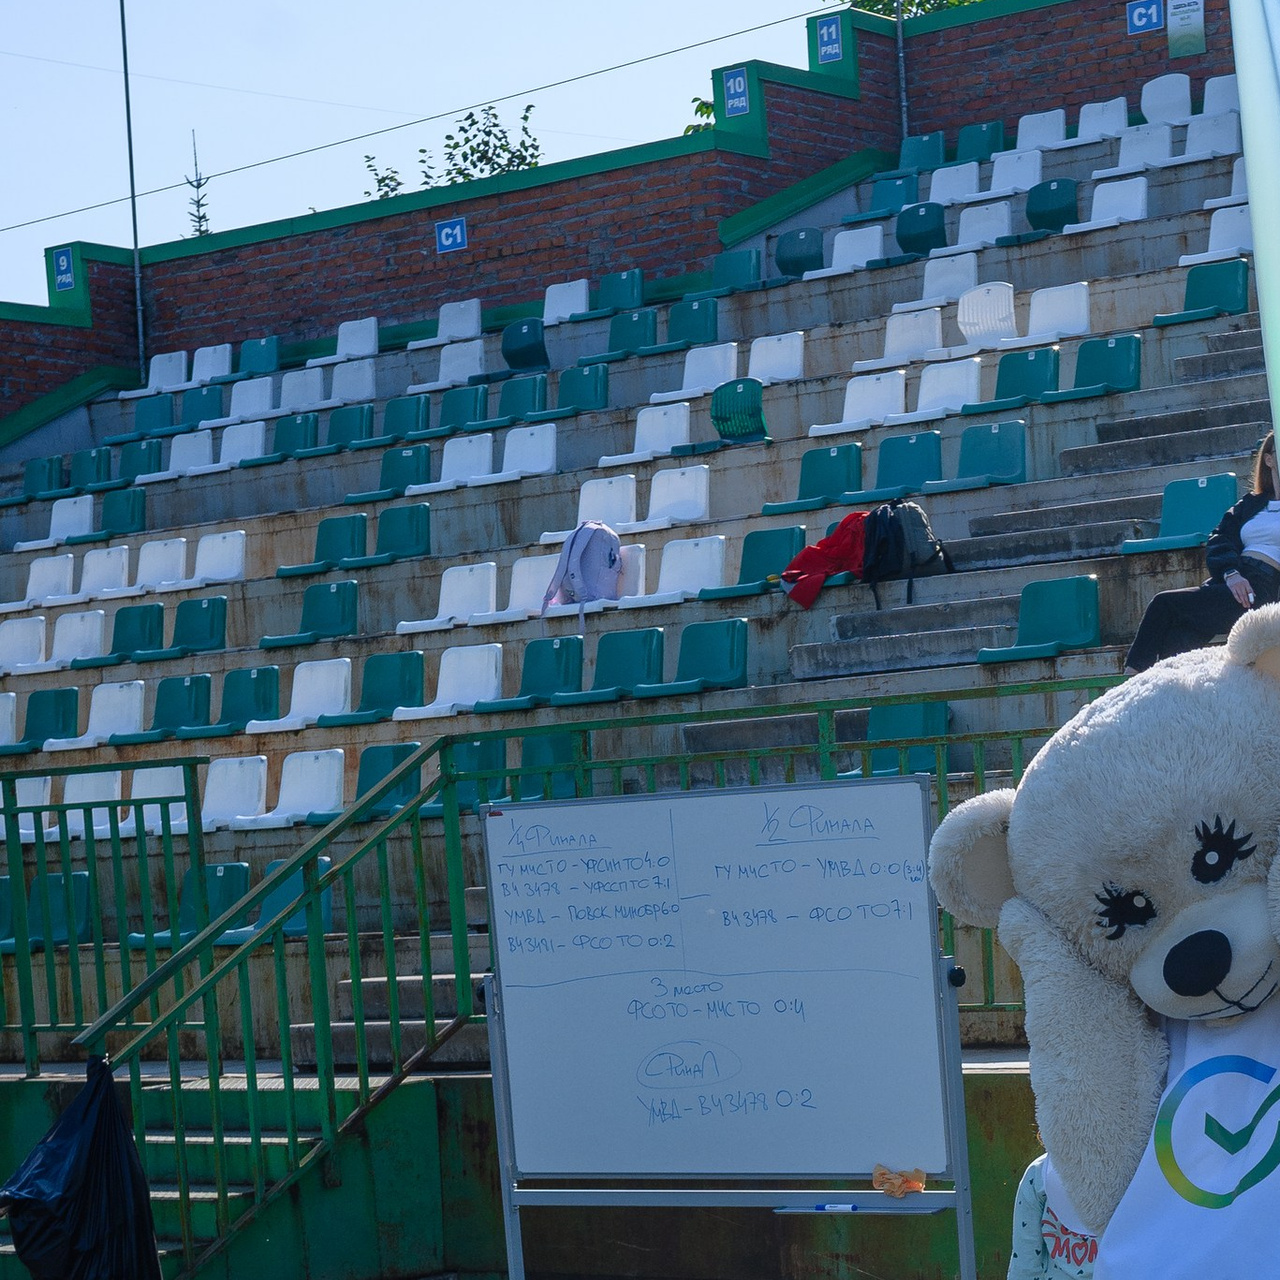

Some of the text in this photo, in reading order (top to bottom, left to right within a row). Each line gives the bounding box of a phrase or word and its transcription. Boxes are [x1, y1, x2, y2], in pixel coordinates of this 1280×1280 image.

[1133, 5, 1157, 26] С1
[820, 24, 836, 41] 11
[821, 44, 839, 55] РЯД
[727, 77, 744, 94] 10
[728, 97, 746, 108] РЯД
[441, 225, 461, 246] С1
[59, 256, 67, 270] 9
[57, 273, 72, 283] РЯД
